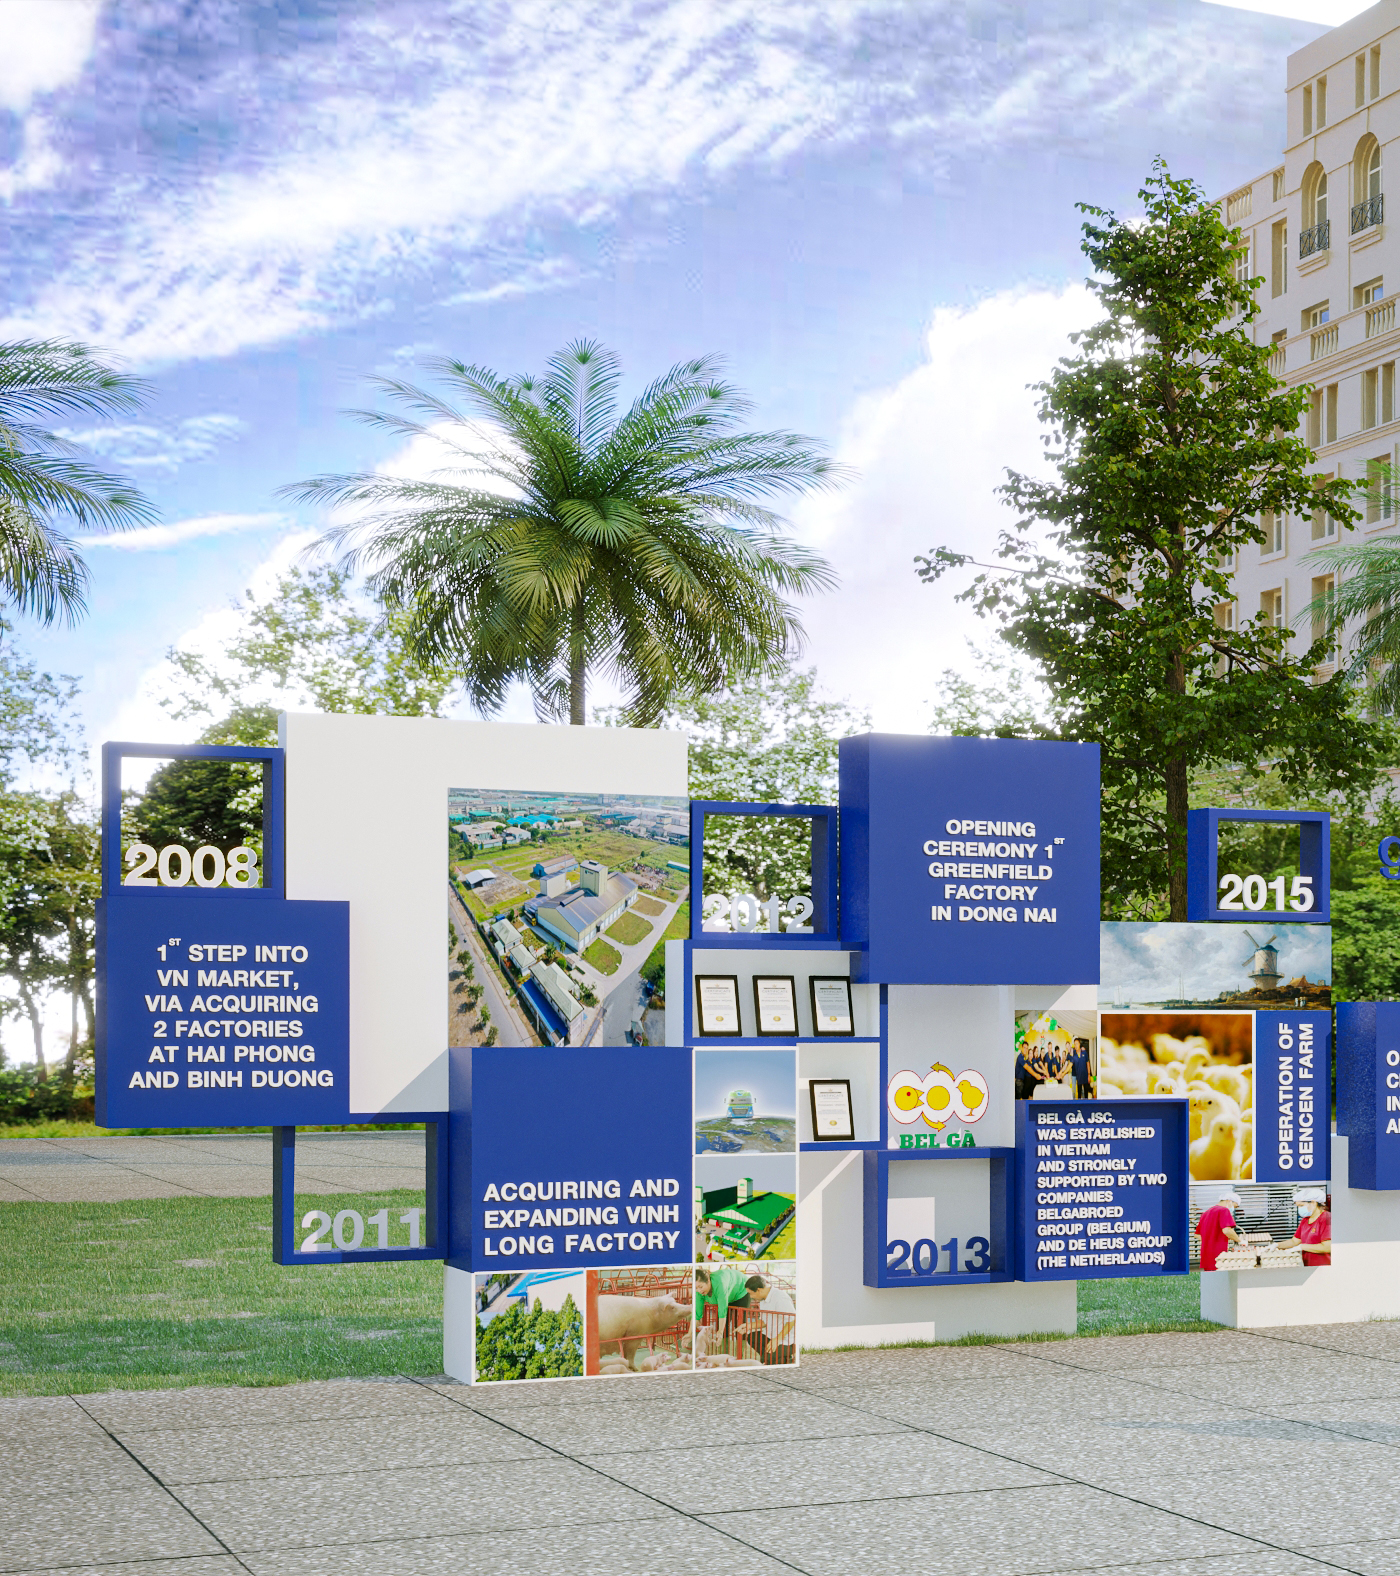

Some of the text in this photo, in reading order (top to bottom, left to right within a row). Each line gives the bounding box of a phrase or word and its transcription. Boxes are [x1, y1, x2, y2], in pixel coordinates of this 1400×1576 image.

[946, 819, 1035, 837] OPENING
[924, 840, 1038, 858] CEREMONY
[124, 843, 260, 889] 2008
[929, 862, 1052, 880] GREENFIELD
[945, 884, 1038, 900] FACTORY
[1219, 873, 1314, 912] 2015
[701, 893, 815, 934] 2012
[932, 906, 1056, 922] IN DONG NAI
[189, 944, 247, 961] STEP
[256, 946, 308, 962] INTO
[157, 970, 298, 990] VN MARKET,
[145, 995, 318, 1013] VIA ACQUIRING
[154, 1020, 303, 1037] 2 FACTORIES
[149, 1045, 315, 1062] AT HAI PHONG
[129, 1070, 333, 1088] AND BINH DUONG
[1279, 1023, 1293, 1169] OPERATION OF
[1299, 1024, 1313, 1169] GENCEN FARM
[1038, 1113, 1062, 1124] BEL
[1088, 1112, 1115, 1123] JSC.
[900, 1134, 940, 1148] BEL
[1037, 1127, 1155, 1140] WAS ESTABLISHED
[1038, 1144, 1110, 1156] IN VIETNAM
[1037, 1159, 1136, 1172] AND STRONGLY
[484, 1179, 679, 1201] ACQUIRING AND
[1038, 1174, 1167, 1188] SUPPORTED BY TWO
[1038, 1191, 1113, 1204] COMPANIES
[485, 1205, 678, 1228] EXPANDING VINH
[1038, 1206, 1123, 1220] BELGABROED
[301, 1207, 421, 1253] 2011
[1038, 1221, 1150, 1236] GROUP (BELGIUM)
[485, 1231, 680, 1255] LONG FACTORY
[1037, 1236, 1172, 1252] AND DE HEUS GROUP
[887, 1237, 991, 1277] 2013
[1038, 1251, 1165, 1270] (THE NETHERLANDS)
